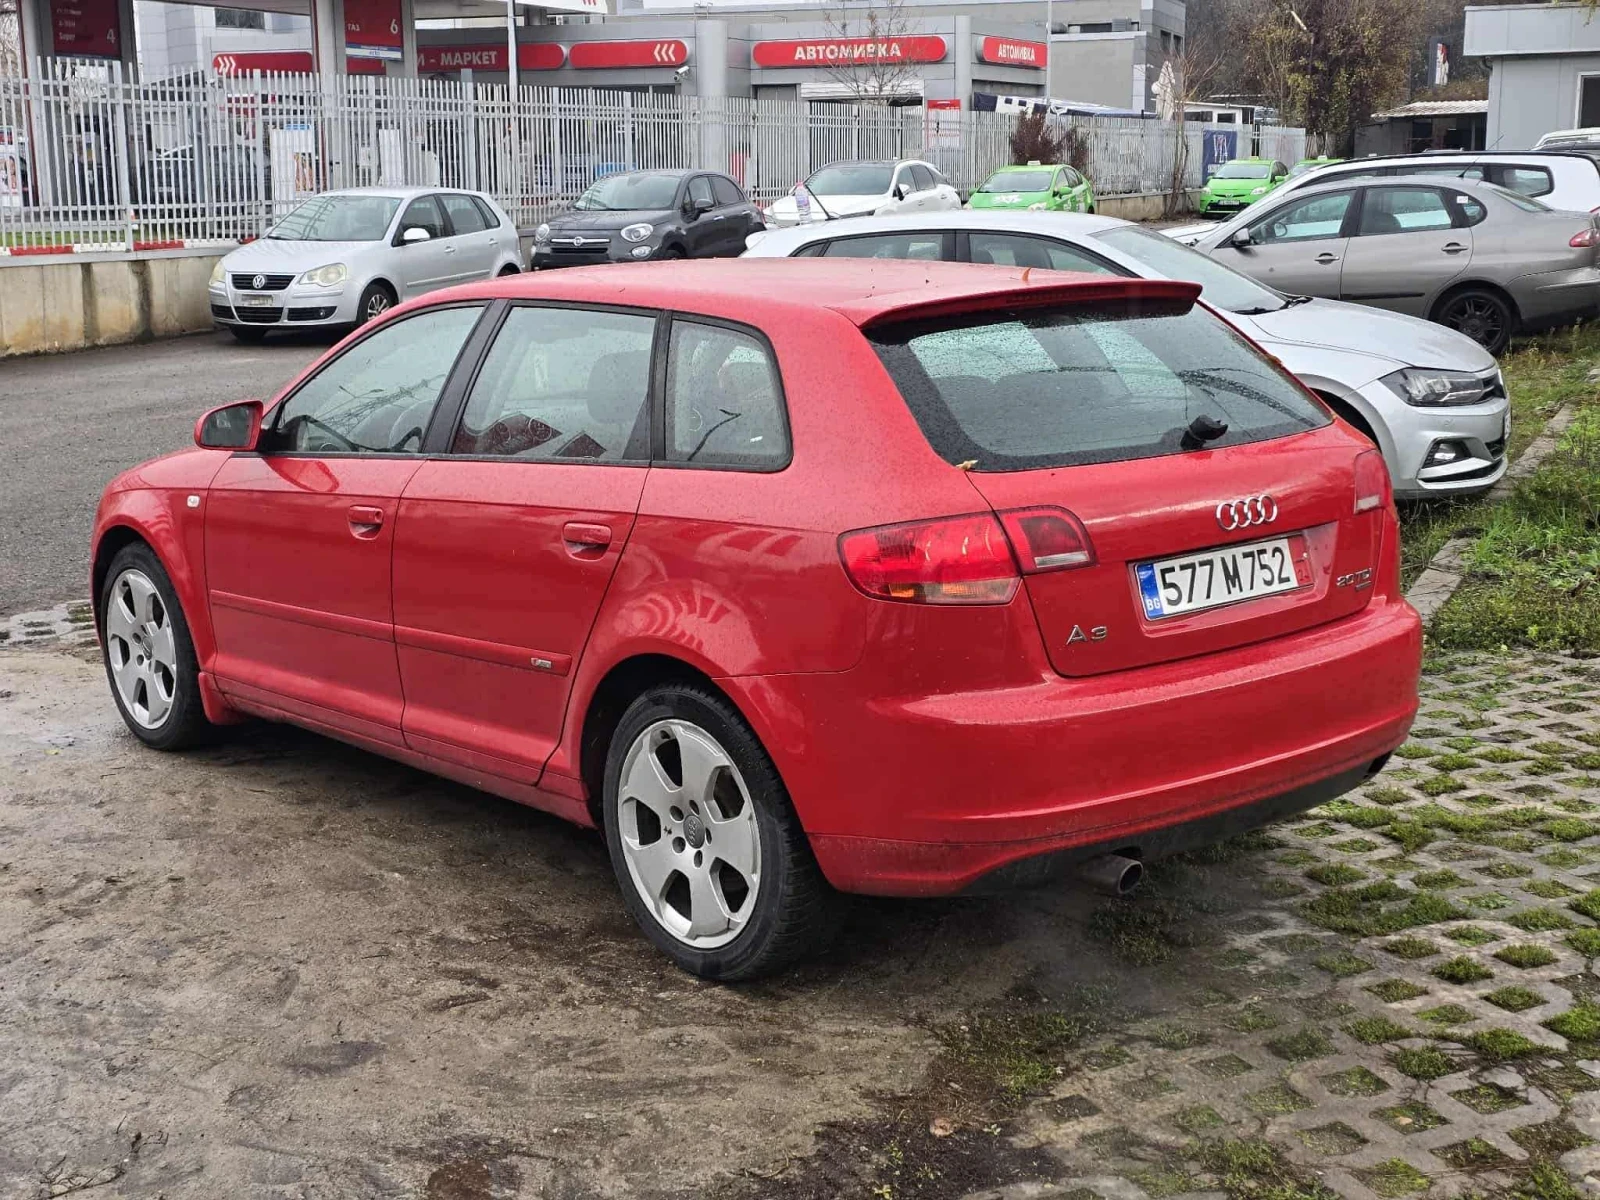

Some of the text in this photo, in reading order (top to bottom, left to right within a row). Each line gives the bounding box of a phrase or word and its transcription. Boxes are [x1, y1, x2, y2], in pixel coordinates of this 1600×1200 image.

[389, 18, 399, 35] 6
[440, 50, 498, 66] МАРКЕТ
[794, 42, 902, 61] АВТОМИВКА
[997, 43, 1036, 62] АВТОМИВКА
[1145, 597, 1161, 611] BG
[1065, 624, 1108, 646] A3
